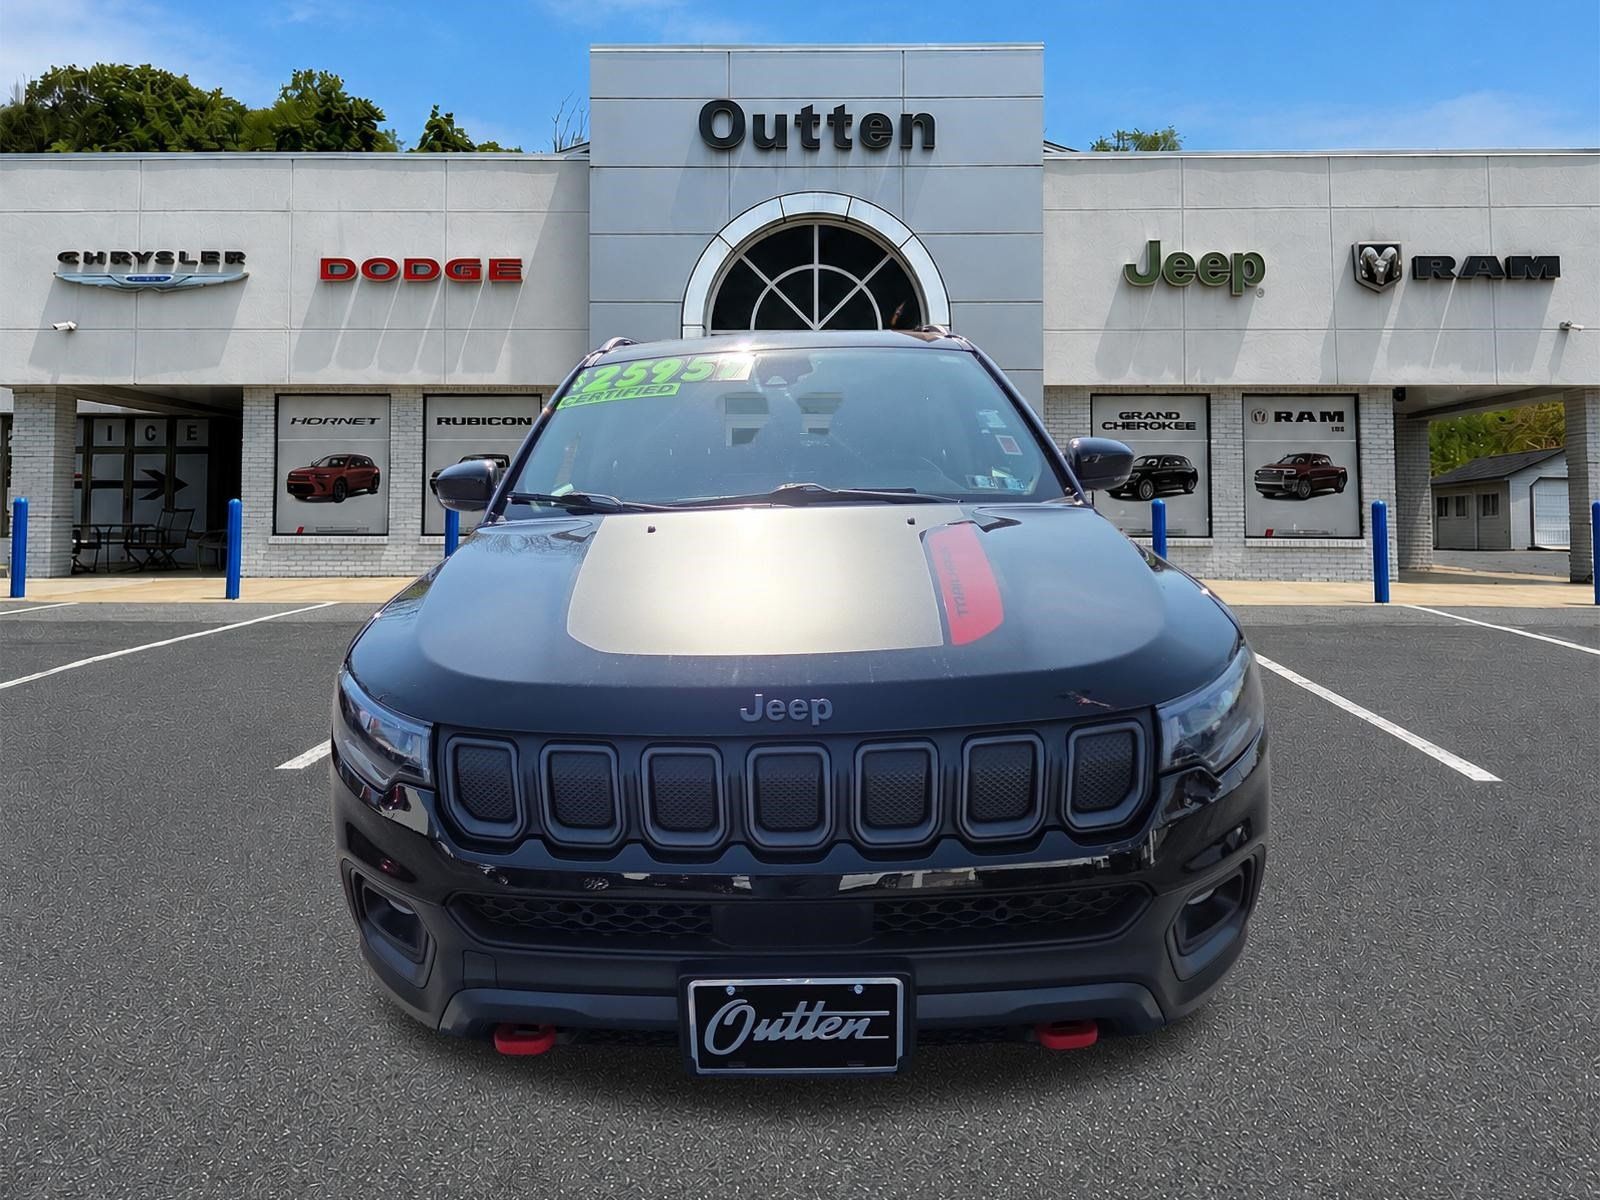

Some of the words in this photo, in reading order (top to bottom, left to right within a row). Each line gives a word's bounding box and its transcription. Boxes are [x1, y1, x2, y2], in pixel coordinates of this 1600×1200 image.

[699, 99, 936, 150] Outten
[57, 250, 247, 265] CHRYSLER
[1123, 239, 1266, 296] Jeep
[1412, 255, 1561, 280] RAM
[320, 257, 523, 282] DODGE
[562, 384, 675, 407] CERTIFIED
[290, 417, 381, 426] HORNET
[436, 416, 533, 426] RUBICON
[1101, 421, 1197, 431] CHEROKEE
[1118, 411, 1181, 421] GRAND
[1274, 410, 1345, 423] RAM
[740, 693, 833, 726] Jeep
[704, 998, 890, 1056] Outten
